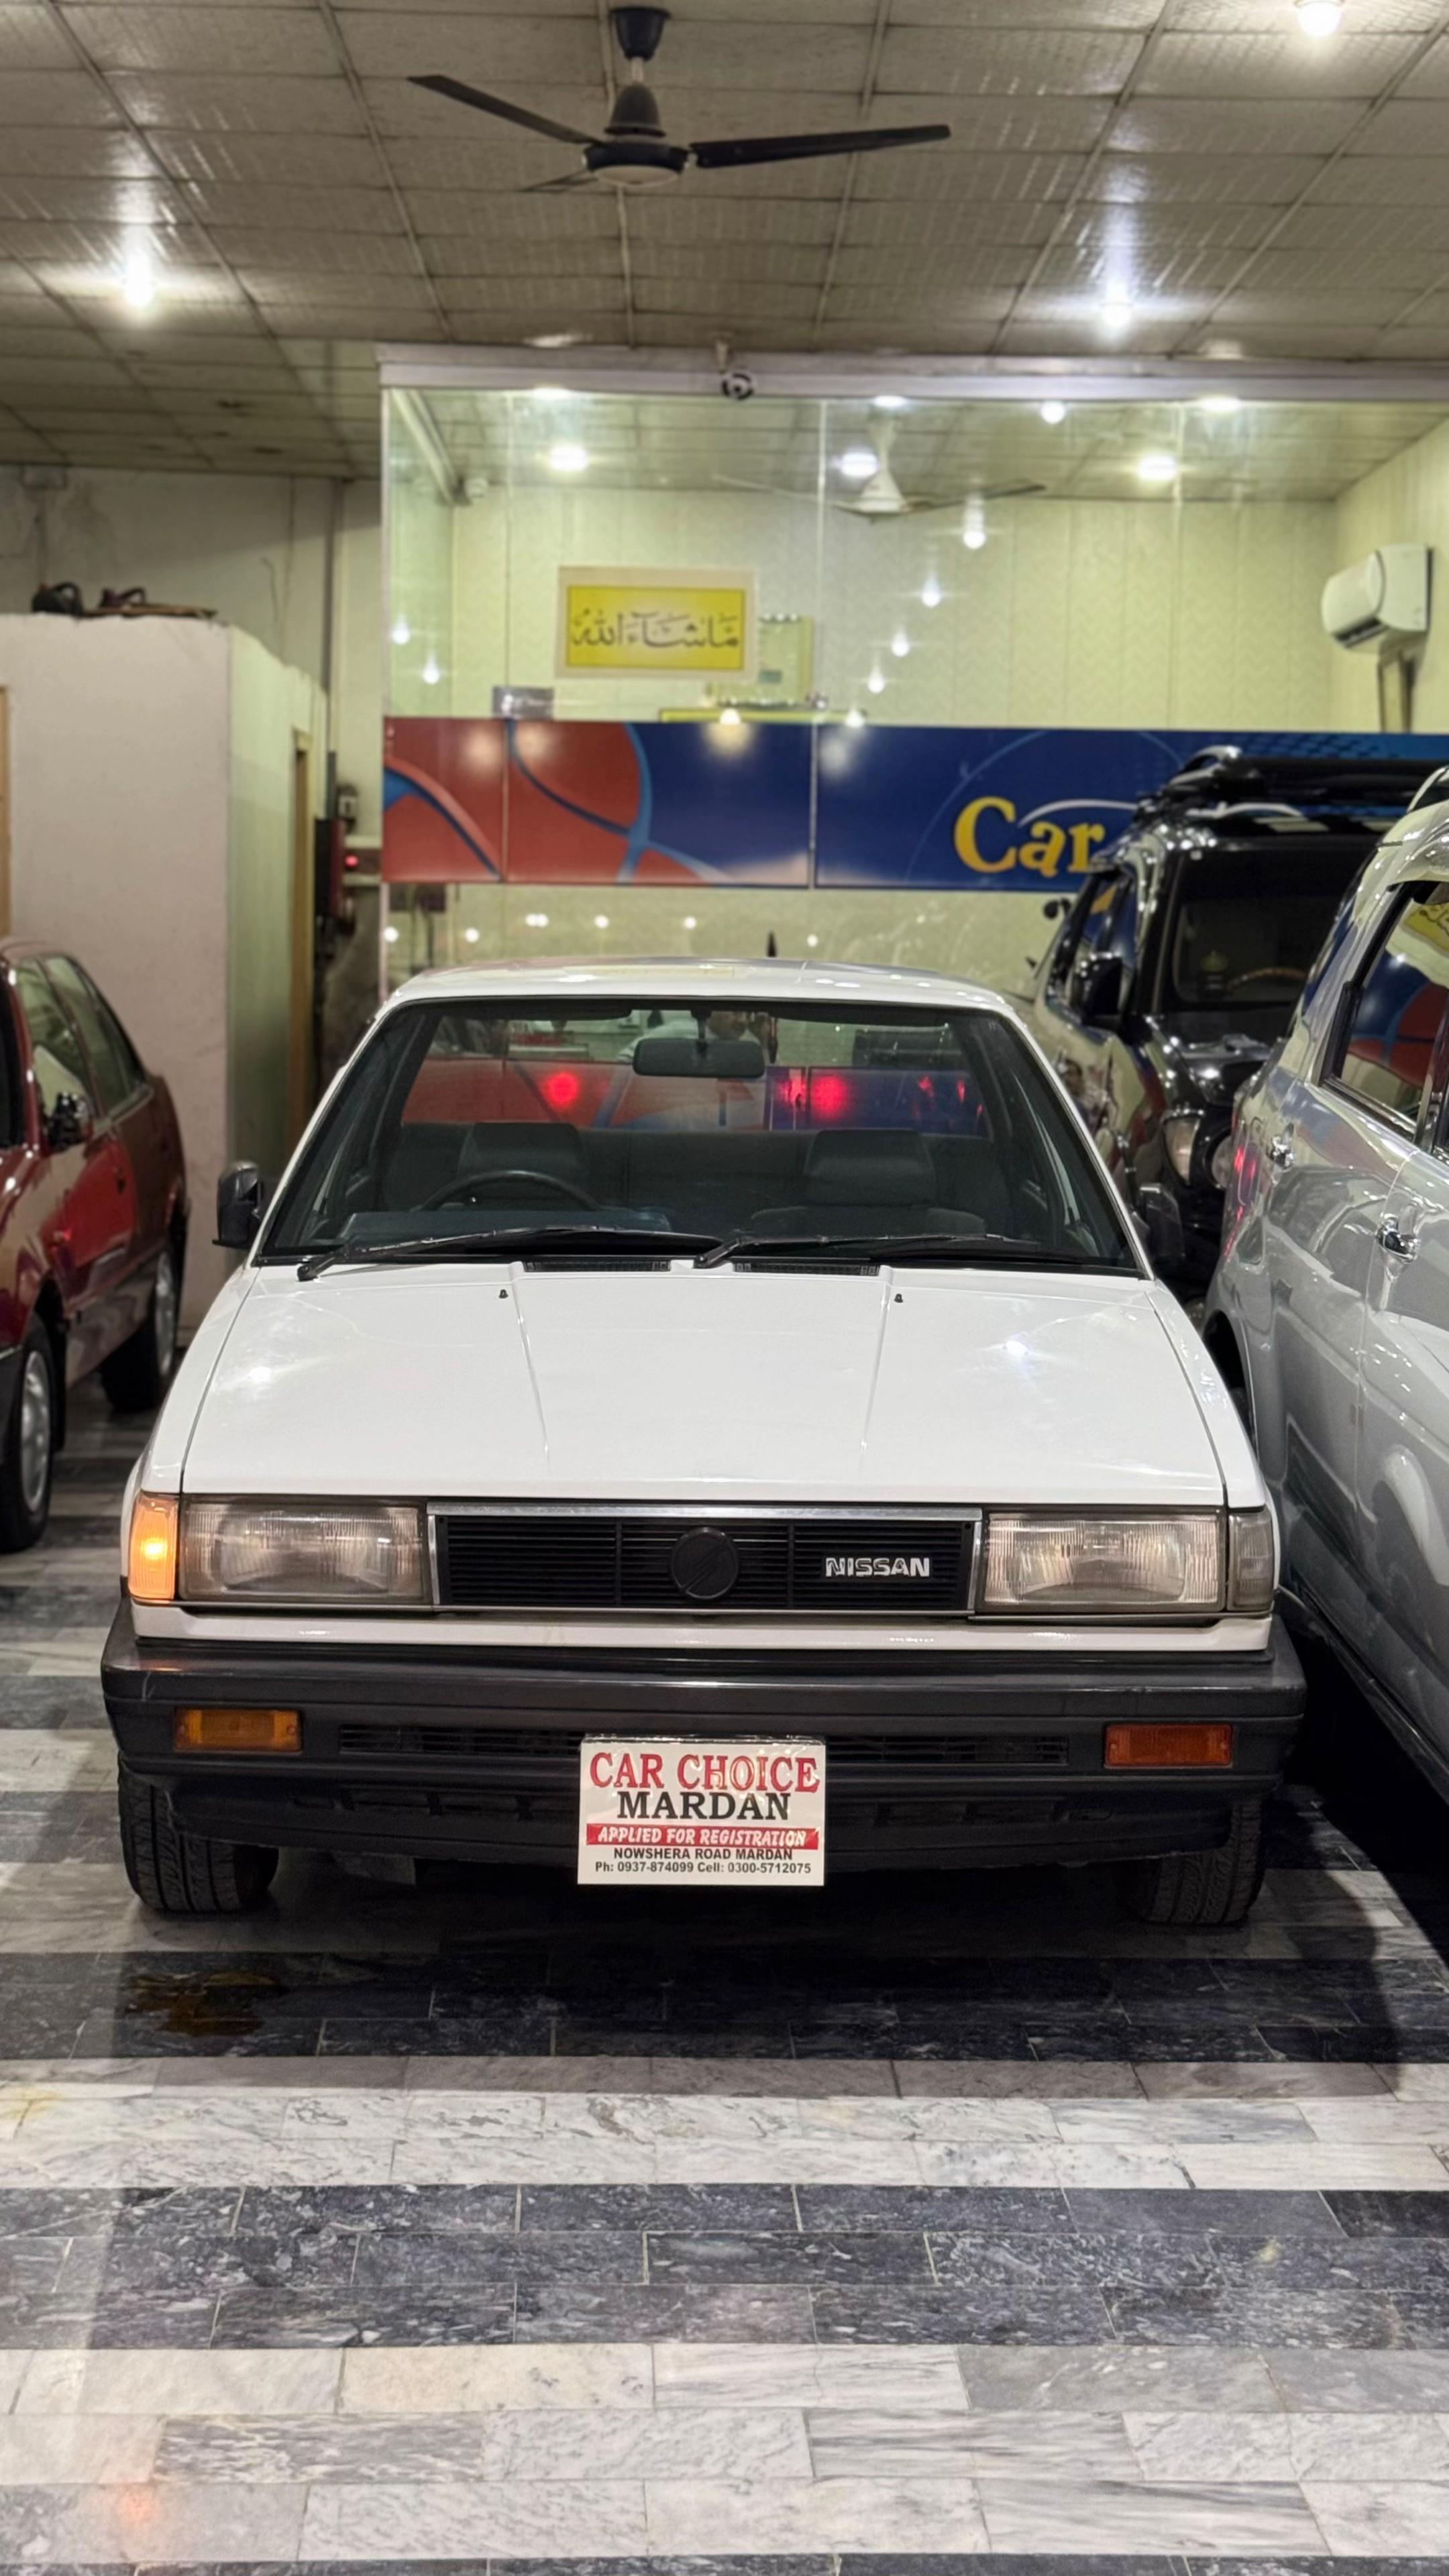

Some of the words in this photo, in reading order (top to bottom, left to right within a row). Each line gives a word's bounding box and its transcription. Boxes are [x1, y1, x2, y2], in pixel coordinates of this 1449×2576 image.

[954, 796, 1106, 878] Car
[826, 1557, 930, 1577] NISSAN
[590, 1752, 664, 1788] CAR
[677, 1754, 820, 1793] CHOICE
[616, 1791, 791, 1820] MARDAN
[598, 1826, 662, 1843] APPLIED
[666, 1828, 696, 1844] FOR
[700, 1829, 806, 1847] REGISTRATION
[614, 1847, 690, 1860] NOWSHERA
[695, 1848, 731, 1860] ROAD
[735, 1849, 792, 1860] MARDAN
[595, 1862, 614, 1872] Ph:
[617, 1862, 694, 1872] 0937-874099
[697, 1862, 724, 1873] Cell:
[728, 1862, 811, 1874] 0300-5712075
